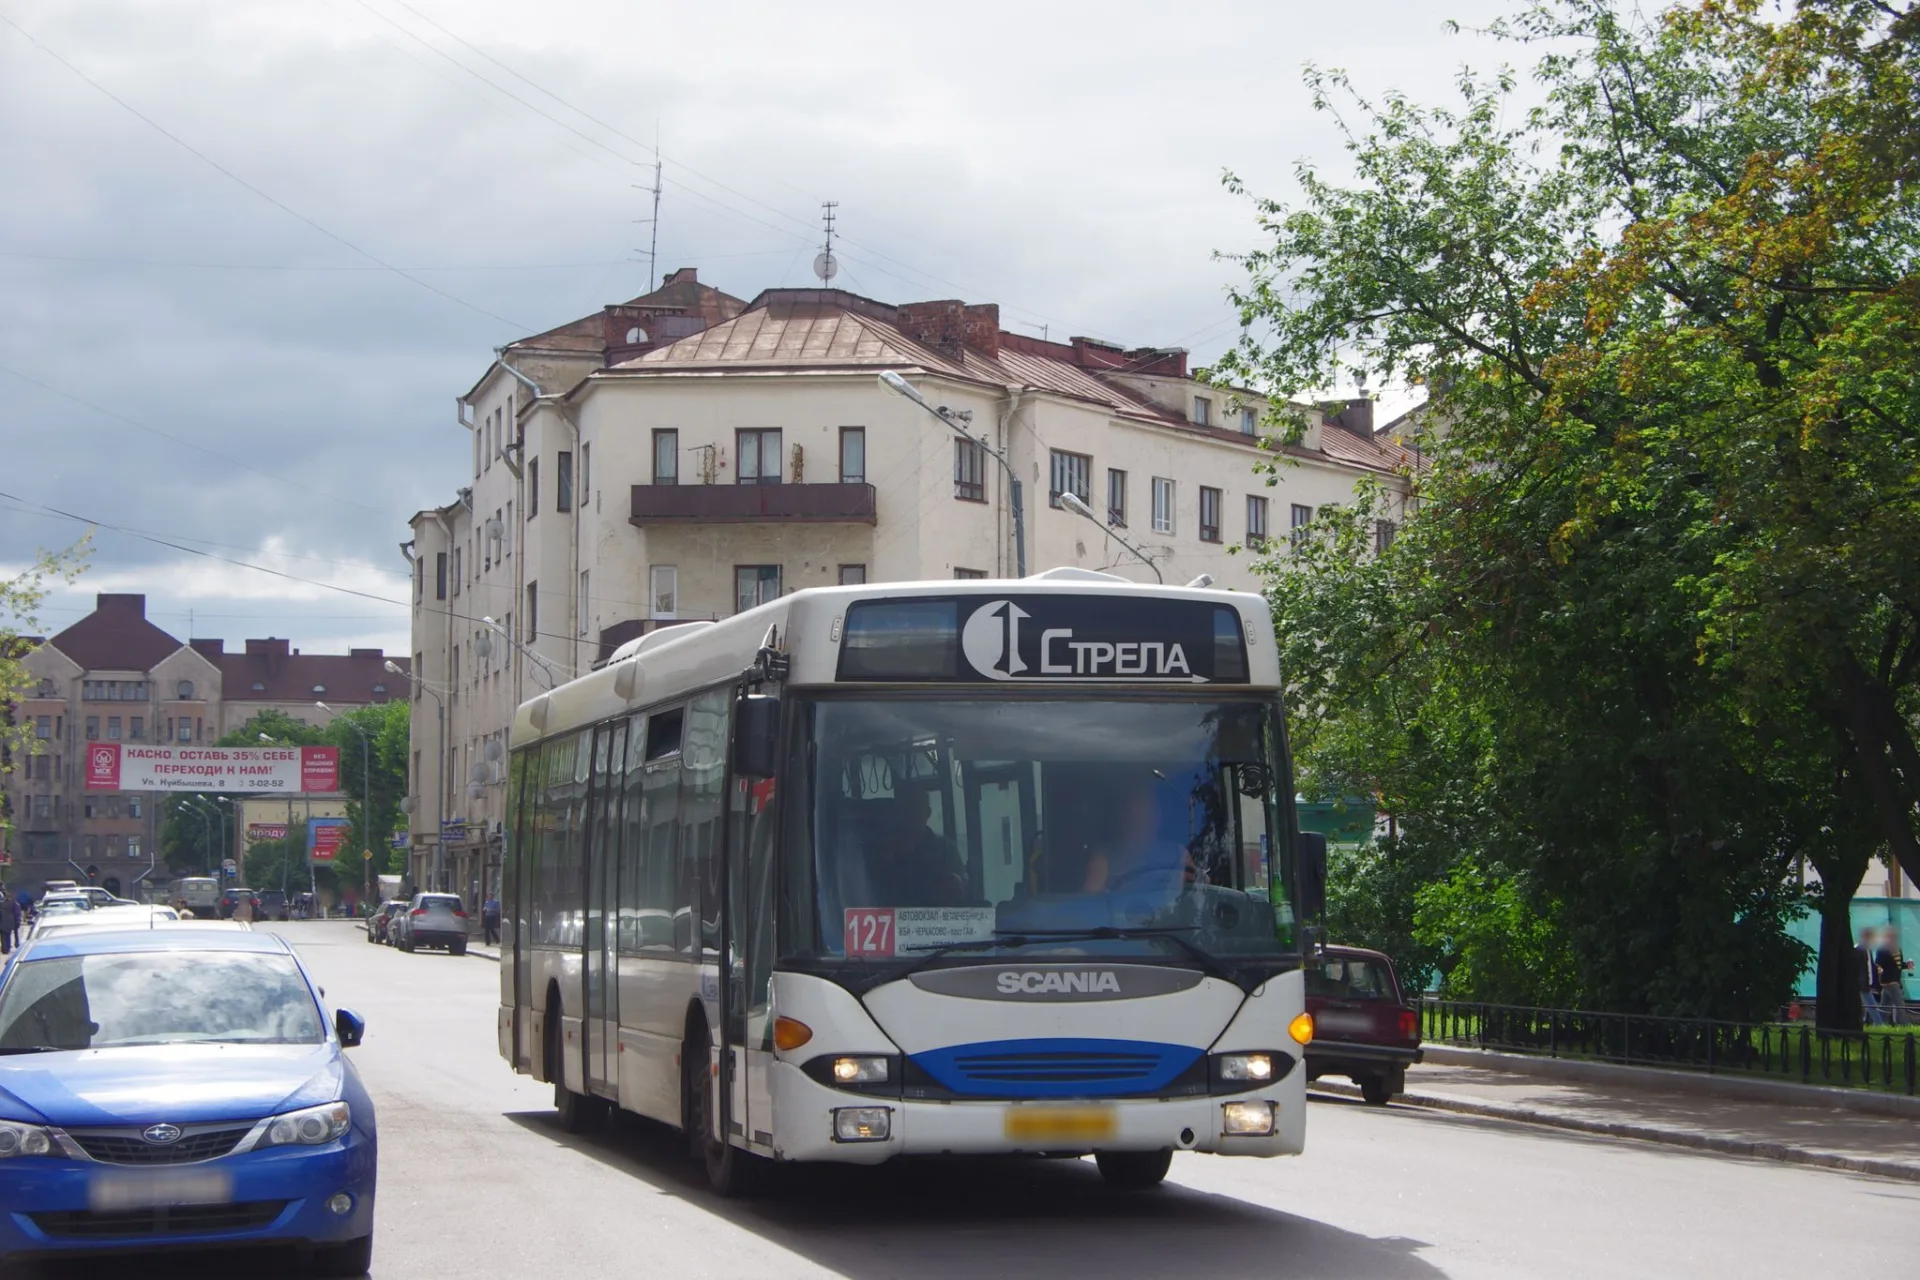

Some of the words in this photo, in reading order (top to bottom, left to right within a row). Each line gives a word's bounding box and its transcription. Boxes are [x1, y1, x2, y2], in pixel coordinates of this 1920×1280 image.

[127, 748, 175, 760] КАСКО.
[180, 750, 229, 760] ОСТАВЬ
[232, 751, 259, 761] 35%
[262, 751, 299, 761] СЕБЕ.
[154, 764, 223, 776] ПЕРЕХОДИ
[226, 765, 236, 775] К
[239, 765, 273, 776] НАМ!
[248, 779, 284, 788] 3-02-52
[898, 911, 939, 921] АВТОВОКЗАЛ
[848, 914, 892, 951] 127
[996, 971, 1121, 994] SCANIA
